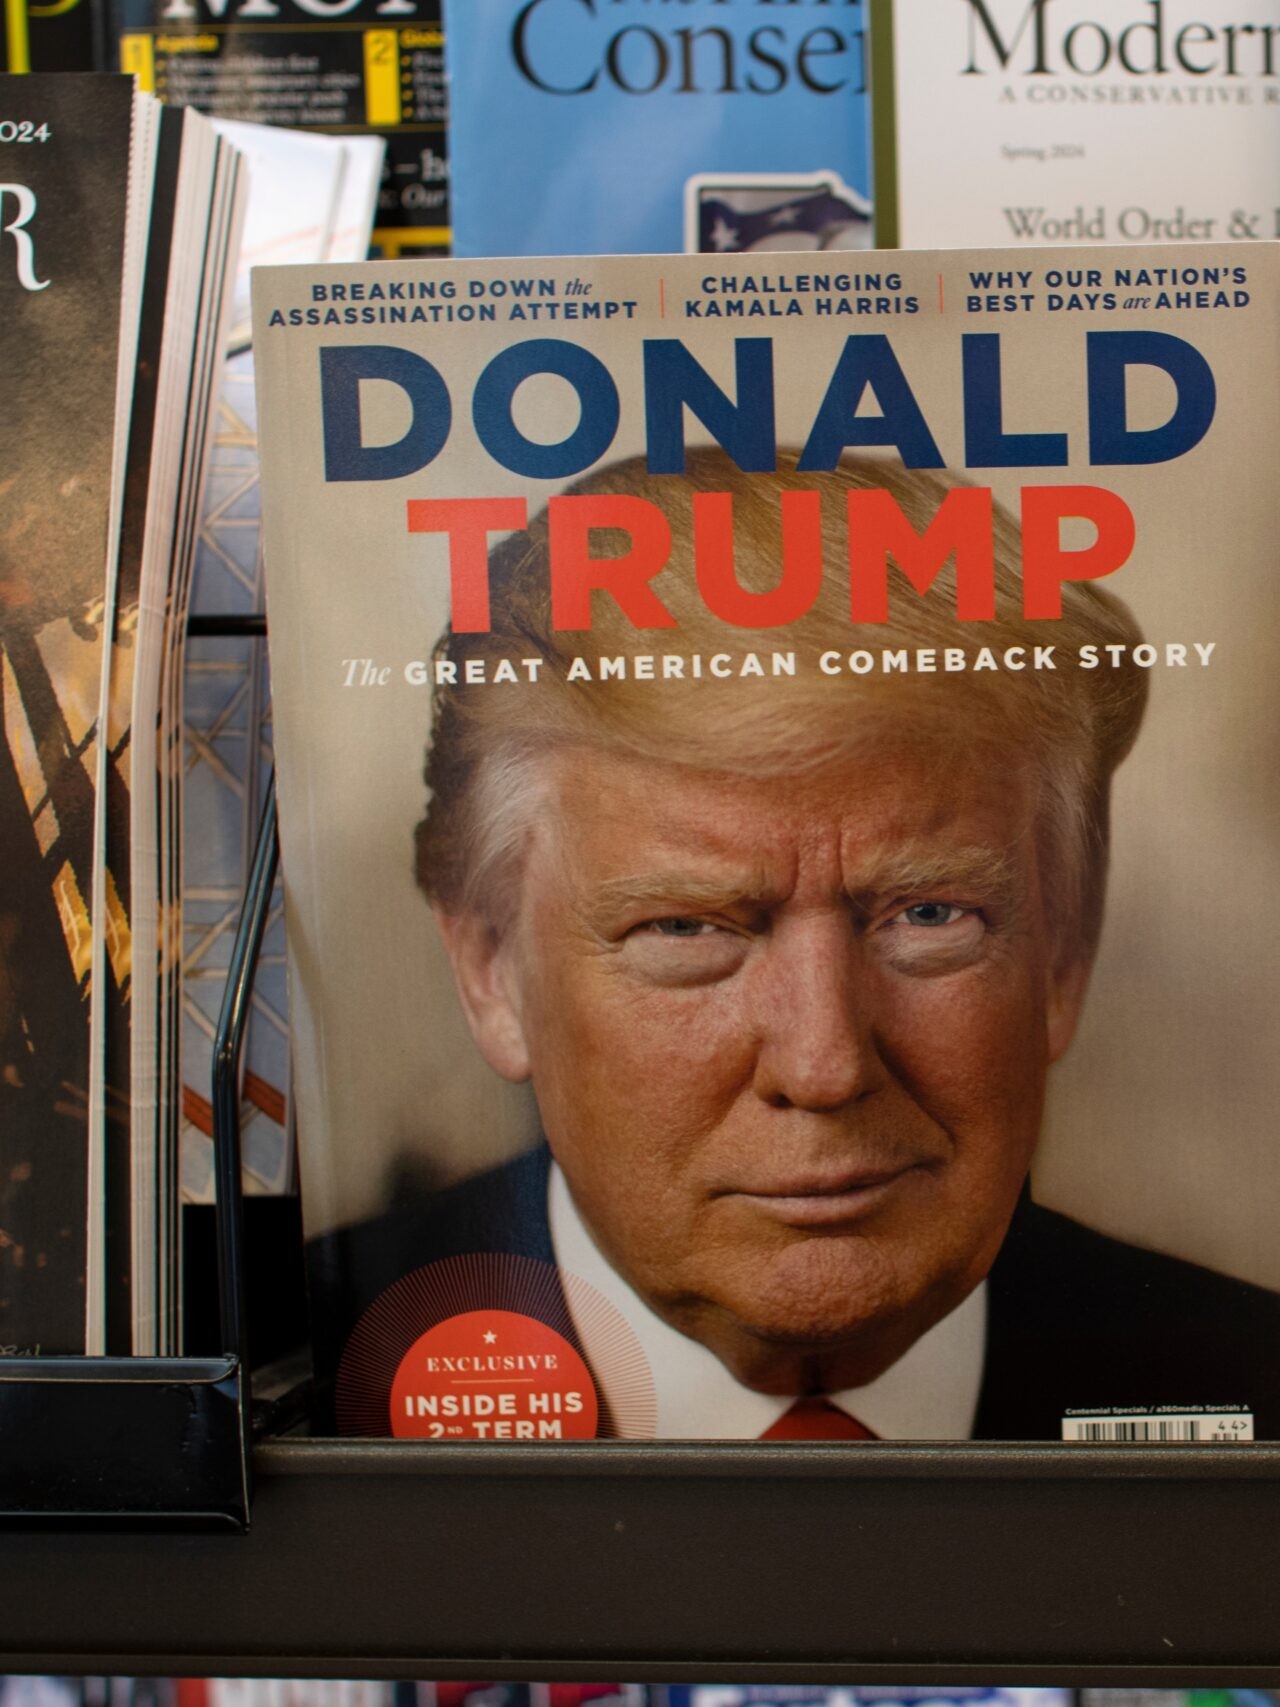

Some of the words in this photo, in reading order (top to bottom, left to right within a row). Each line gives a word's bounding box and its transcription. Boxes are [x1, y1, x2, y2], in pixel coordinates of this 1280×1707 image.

[1026, 84, 1250, 105] CONSERVATIVE
[1001, 145, 1047, 162] Spring
[1002, 206, 1106, 240] World
[1117, 206, 1217, 240] Order
[1227, 208, 1261, 240] &
[702, 273, 902, 294] CHALLENGING
[969, 270, 1033, 289] WHY
[1045, 269, 1102, 288] OUR
[1115, 267, 1247, 287] NATION’S
[312, 281, 457, 302] BREAKING
[469, 279, 556, 297] DOWN
[565, 278, 593, 297] the
[685, 298, 803, 318] KAMALA
[816, 296, 920, 315] HARRIS
[967, 294, 1035, 313] BEST
[1047, 292, 1117, 311] DAYS
[1123, 295, 1151, 311] are
[1155, 291, 1251, 309] AHEAD
[269, 304, 497, 327] ASSASSINATION
[509, 301, 638, 321] ATTEMPT
[319, 330, 1217, 482] DONALD
[406, 484, 1136, 634] TRUMP
[341, 657, 392, 688] The
[404, 657, 546, 687] GREAT
[566, 649, 798, 682] AMERICAN
[819, 645, 1057, 677] COMEBACK
[1078, 641, 1218, 669] STORY
[426, 1355, 559, 1373] EXCLUSIVE
[405, 1394, 517, 1417] INSIDE
[529, 1392, 584, 1414] HIS
[1065, 1407, 1111, 1416] Centennial
[1112, 1406, 1148, 1415] Specials
[1156, 1404, 1204, 1414] a360media
[1205, 1403, 1241, 1413] Specials
[472, 1419, 562, 1439] TERM
